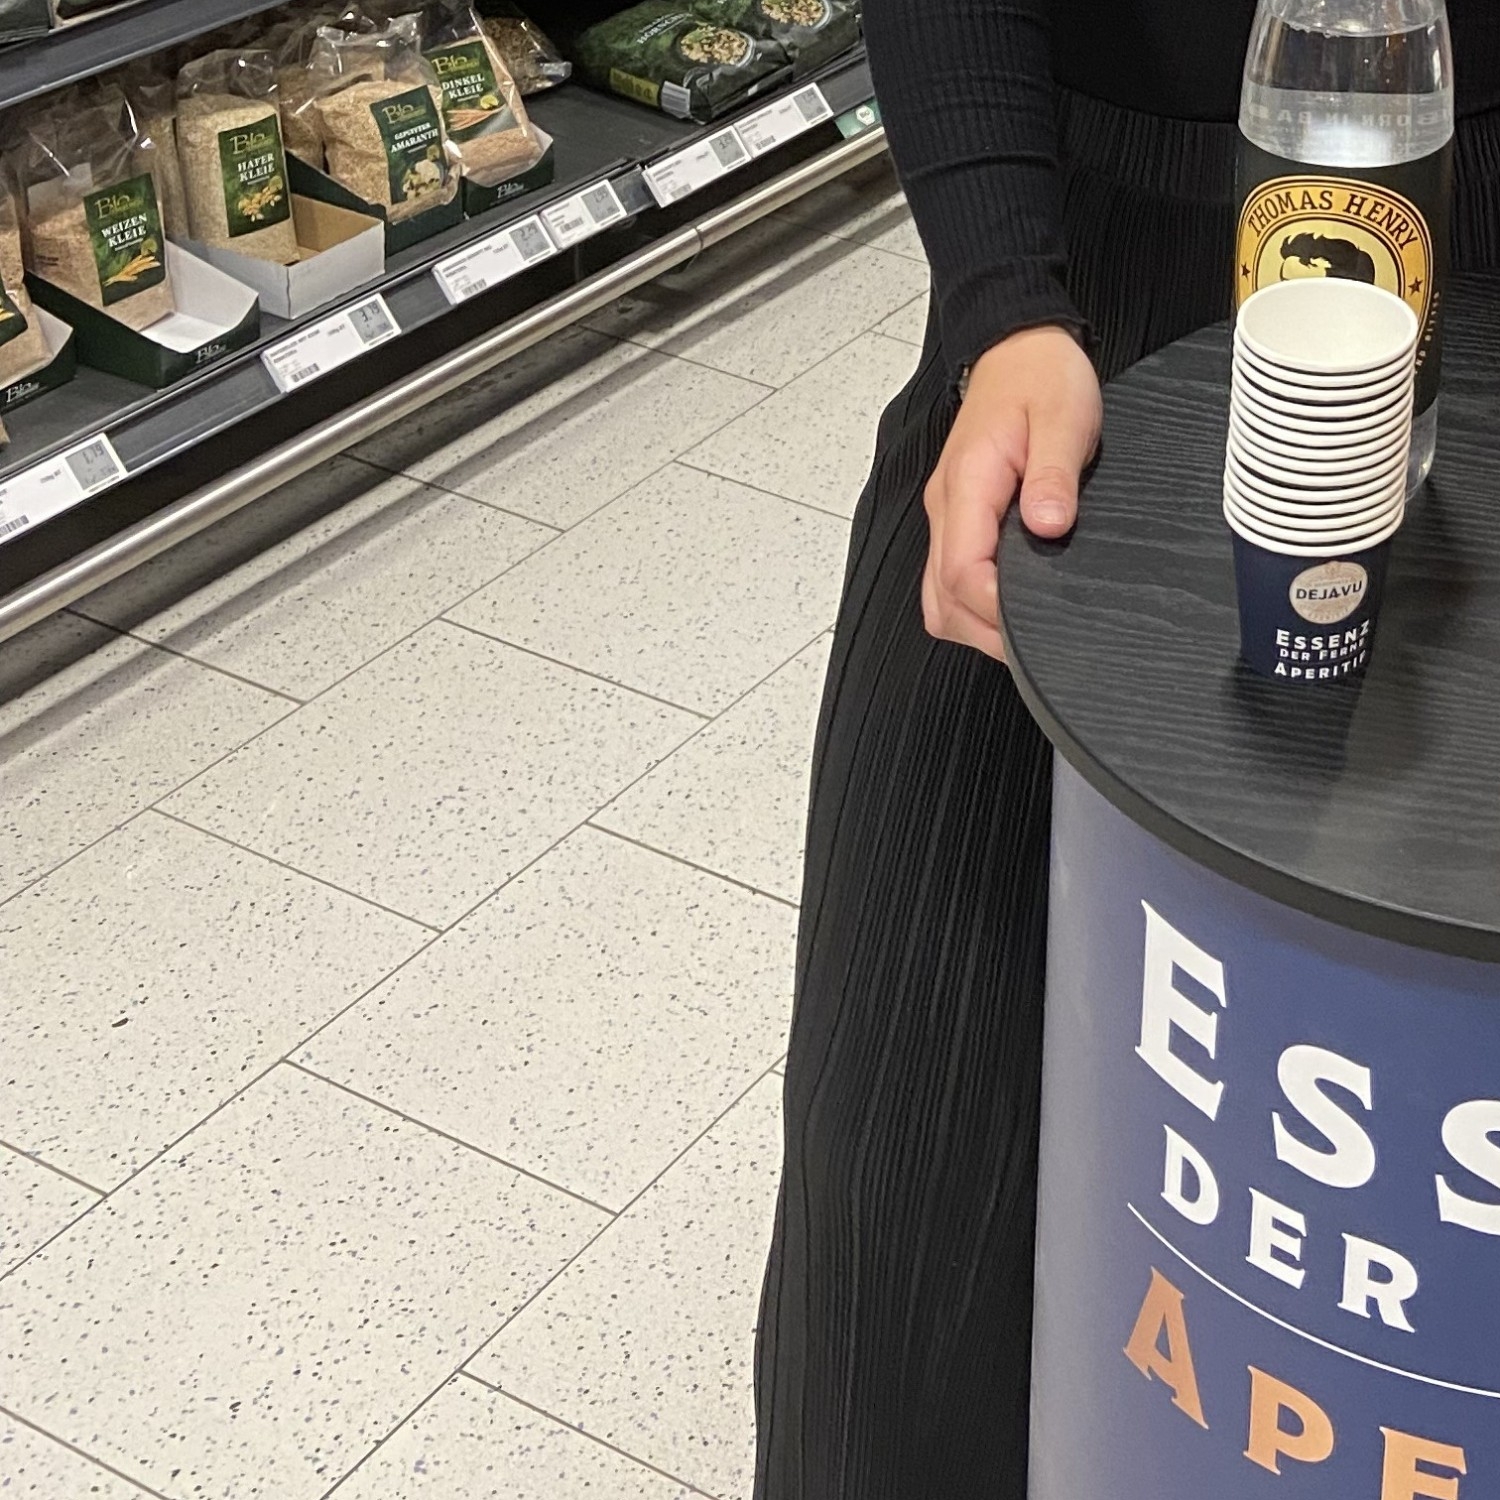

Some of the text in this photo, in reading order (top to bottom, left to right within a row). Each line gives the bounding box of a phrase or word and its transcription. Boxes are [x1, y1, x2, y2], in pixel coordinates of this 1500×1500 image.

[442, 73, 485, 91] DINKEL
[449, 84, 484, 100] KLEIE
[391, 129, 439, 153] AMARANTH
[237, 153, 275, 172] HAFER
[239, 163, 276, 182] KLEIE
[101, 213, 148, 239] WEIZEN
[1248, 190, 1418, 250] THOMAS HENRY
[108, 226, 147, 247] KLEIE
[1276, 618, 1371, 650] ESSENZ
[1274, 650, 1367, 680] APERITIF
[1279, 648, 1311, 662] DER
[1160, 1123, 1421, 1334] DER
